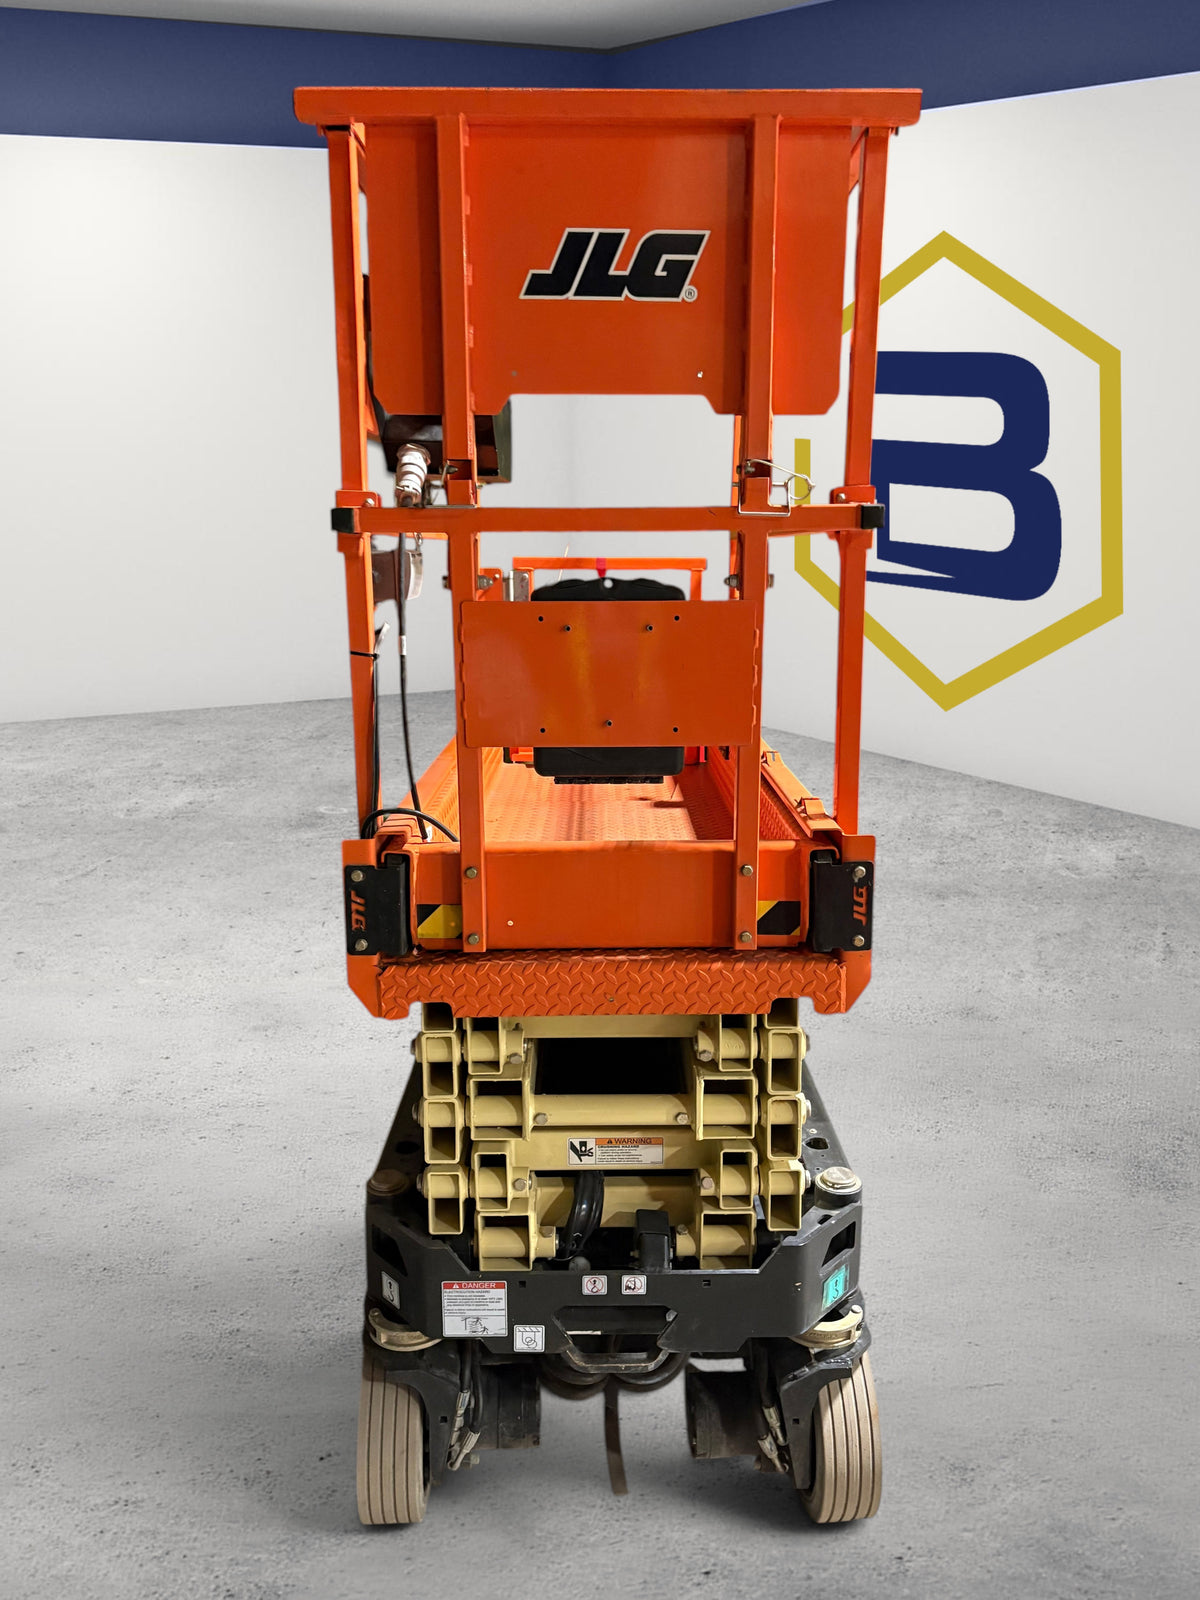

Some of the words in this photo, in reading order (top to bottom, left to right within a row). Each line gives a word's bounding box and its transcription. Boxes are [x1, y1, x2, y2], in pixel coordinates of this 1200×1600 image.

[519, 228, 711, 302] JLG
[350, 889, 366, 932] JLG
[853, 885, 867, 927] JLG
[614, 1137, 652, 1145] WARNING
